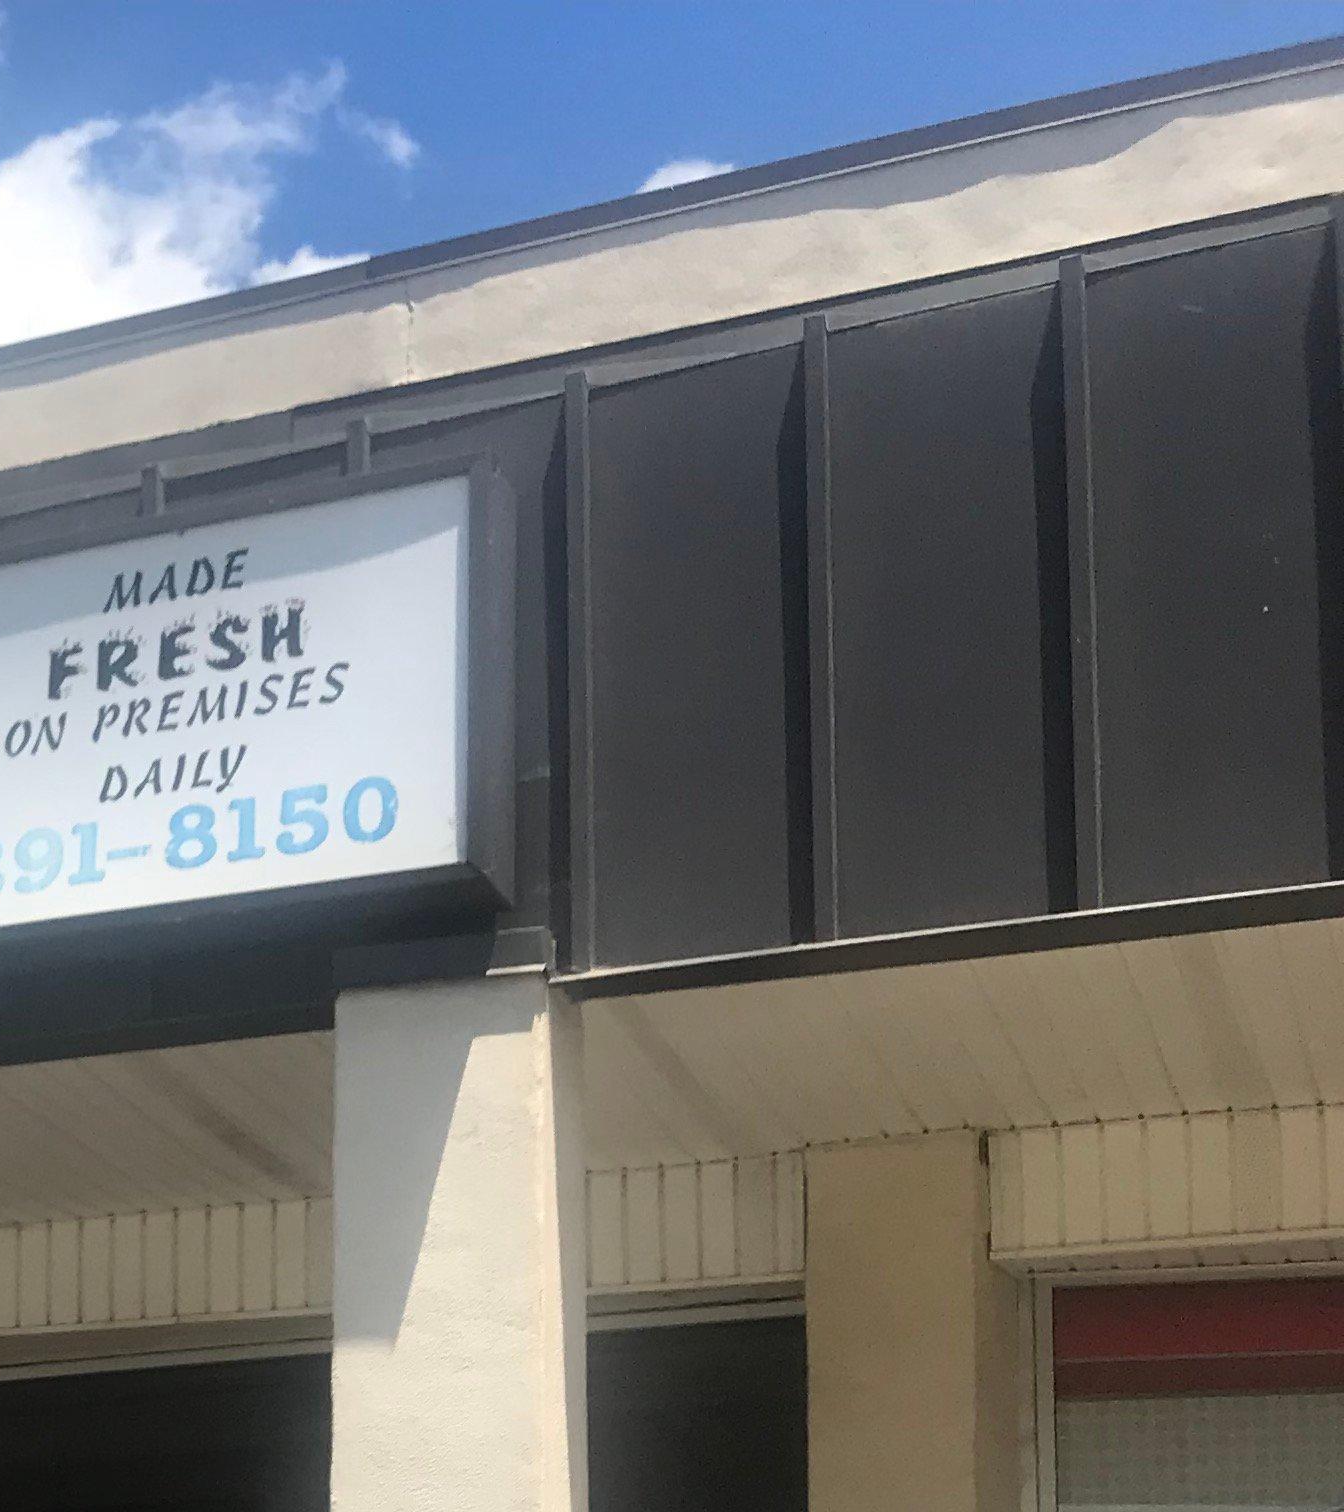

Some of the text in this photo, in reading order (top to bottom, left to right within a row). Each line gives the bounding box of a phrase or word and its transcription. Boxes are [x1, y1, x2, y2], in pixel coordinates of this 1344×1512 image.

[102, 547, 250, 614] MADE
[46, 602, 312, 701] FRESH
[4, 661, 350, 758] ON PREMISES
[97, 744, 247, 805] DAILY
